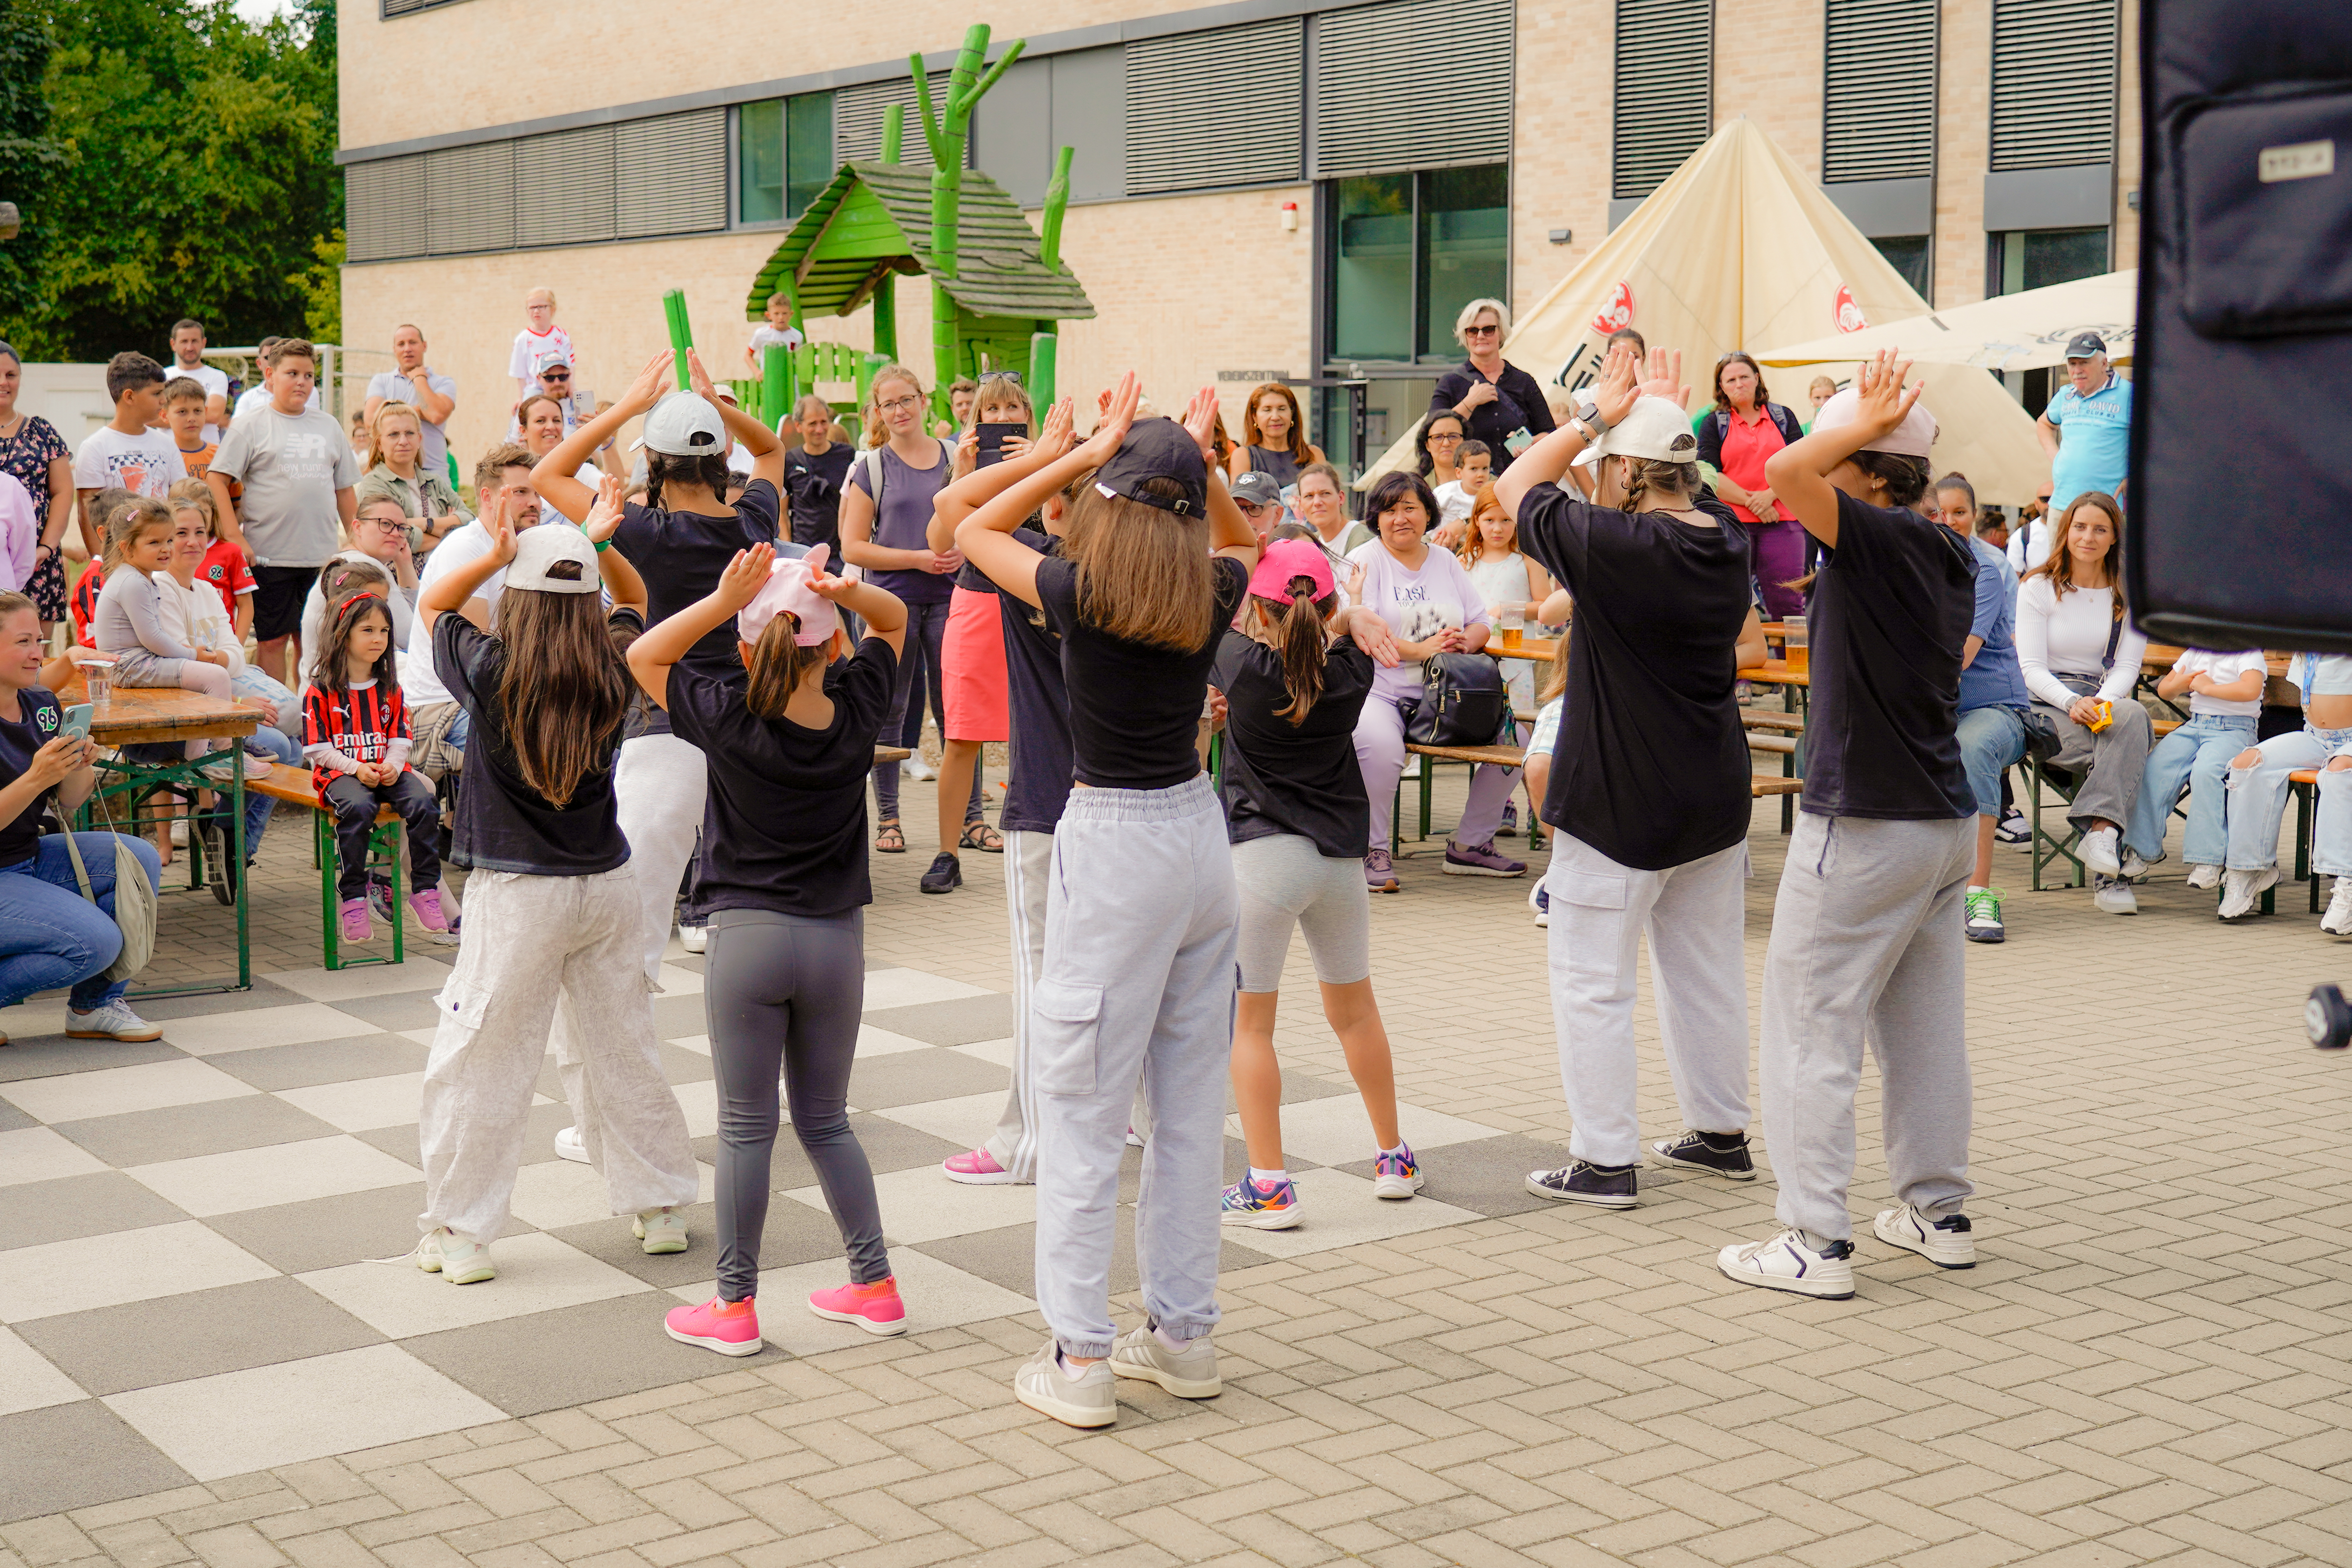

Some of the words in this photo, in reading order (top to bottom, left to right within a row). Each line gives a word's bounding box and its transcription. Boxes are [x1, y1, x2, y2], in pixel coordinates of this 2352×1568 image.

[2089, 400, 2120, 413] DAVID
[278, 463, 298, 472] new
[1394, 585, 1430, 601] EASE
[38, 707, 57, 730] 96
[1090, 1368, 1111, 1377] adidas
